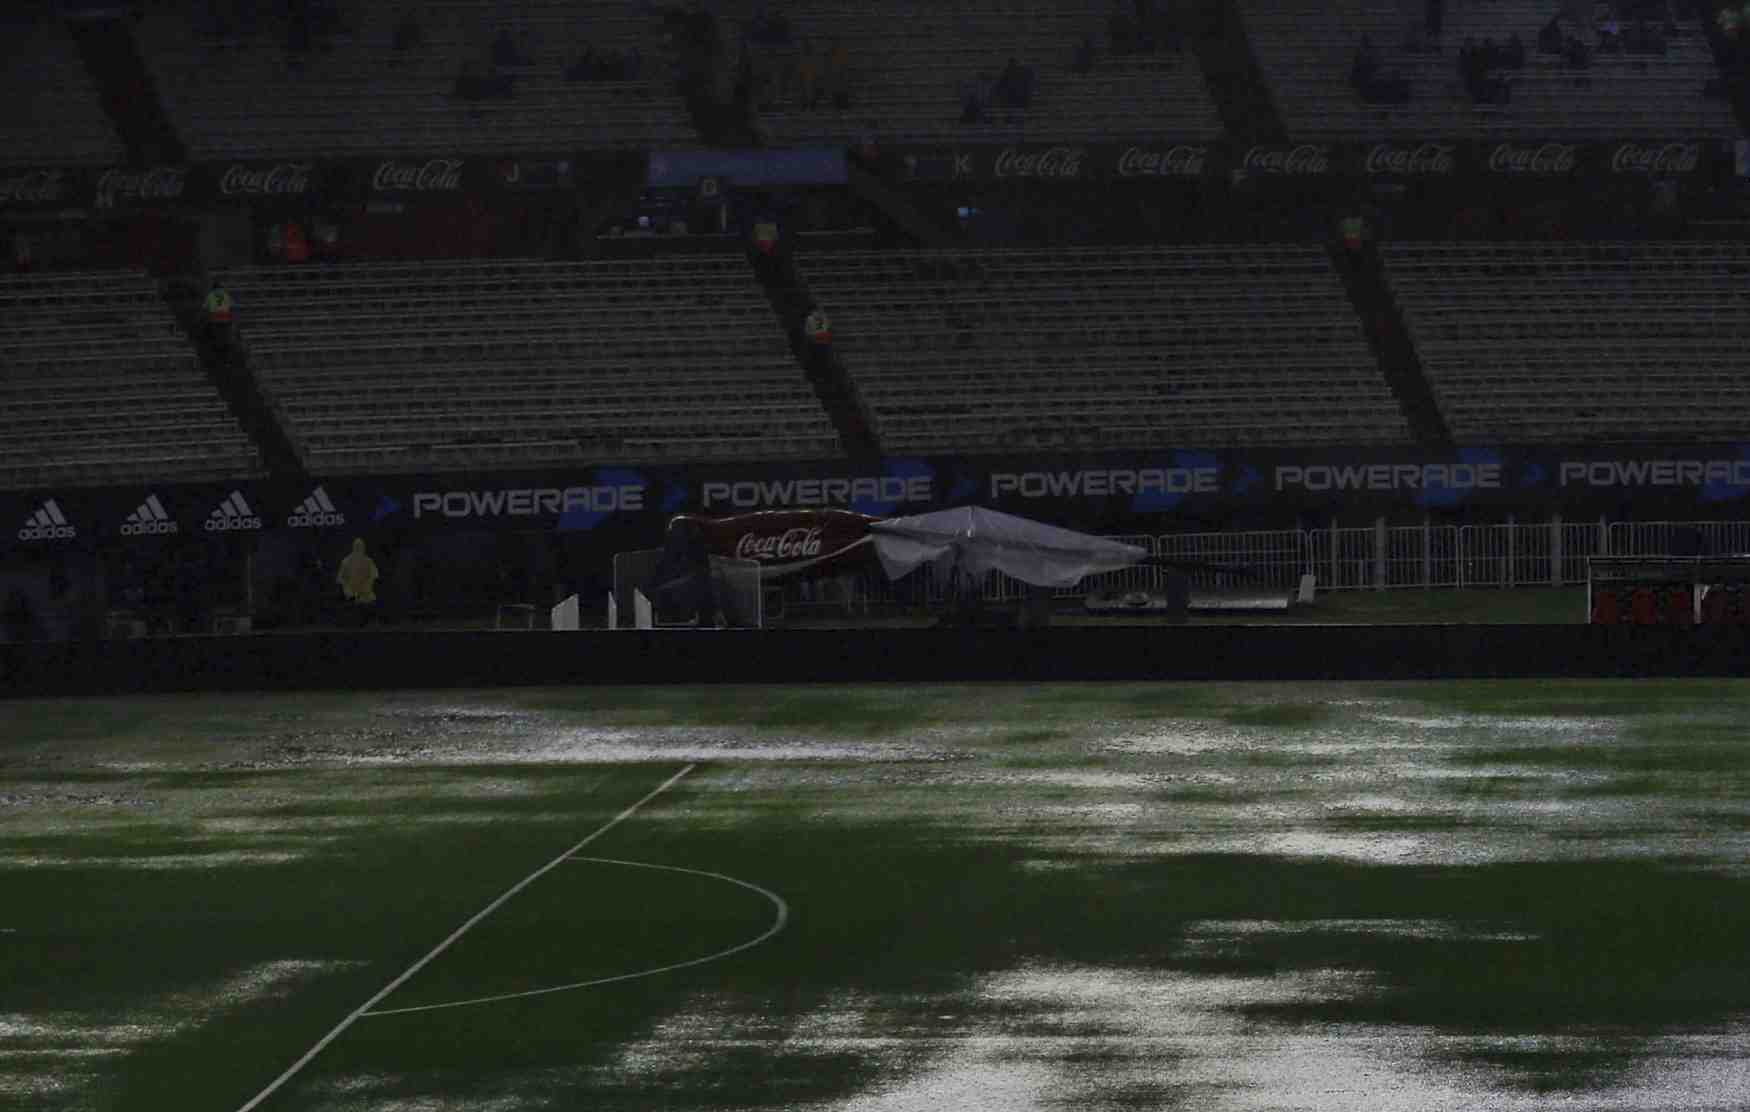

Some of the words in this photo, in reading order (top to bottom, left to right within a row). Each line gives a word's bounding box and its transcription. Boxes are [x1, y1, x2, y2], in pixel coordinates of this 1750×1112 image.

[372, 159, 465, 191] Coca-Cola
[703, 475, 932, 508] POWERADE
[991, 466, 1222, 499] POWERADE
[1274, 463, 1502, 491] POWERADE
[413, 485, 647, 519] POWERADE
[17, 525, 77, 542] adidas
[120, 518, 178, 537] adidas
[204, 514, 262, 532] adidas
[287, 511, 345, 529] adidas
[736, 527, 828, 560] Coca-Cola
